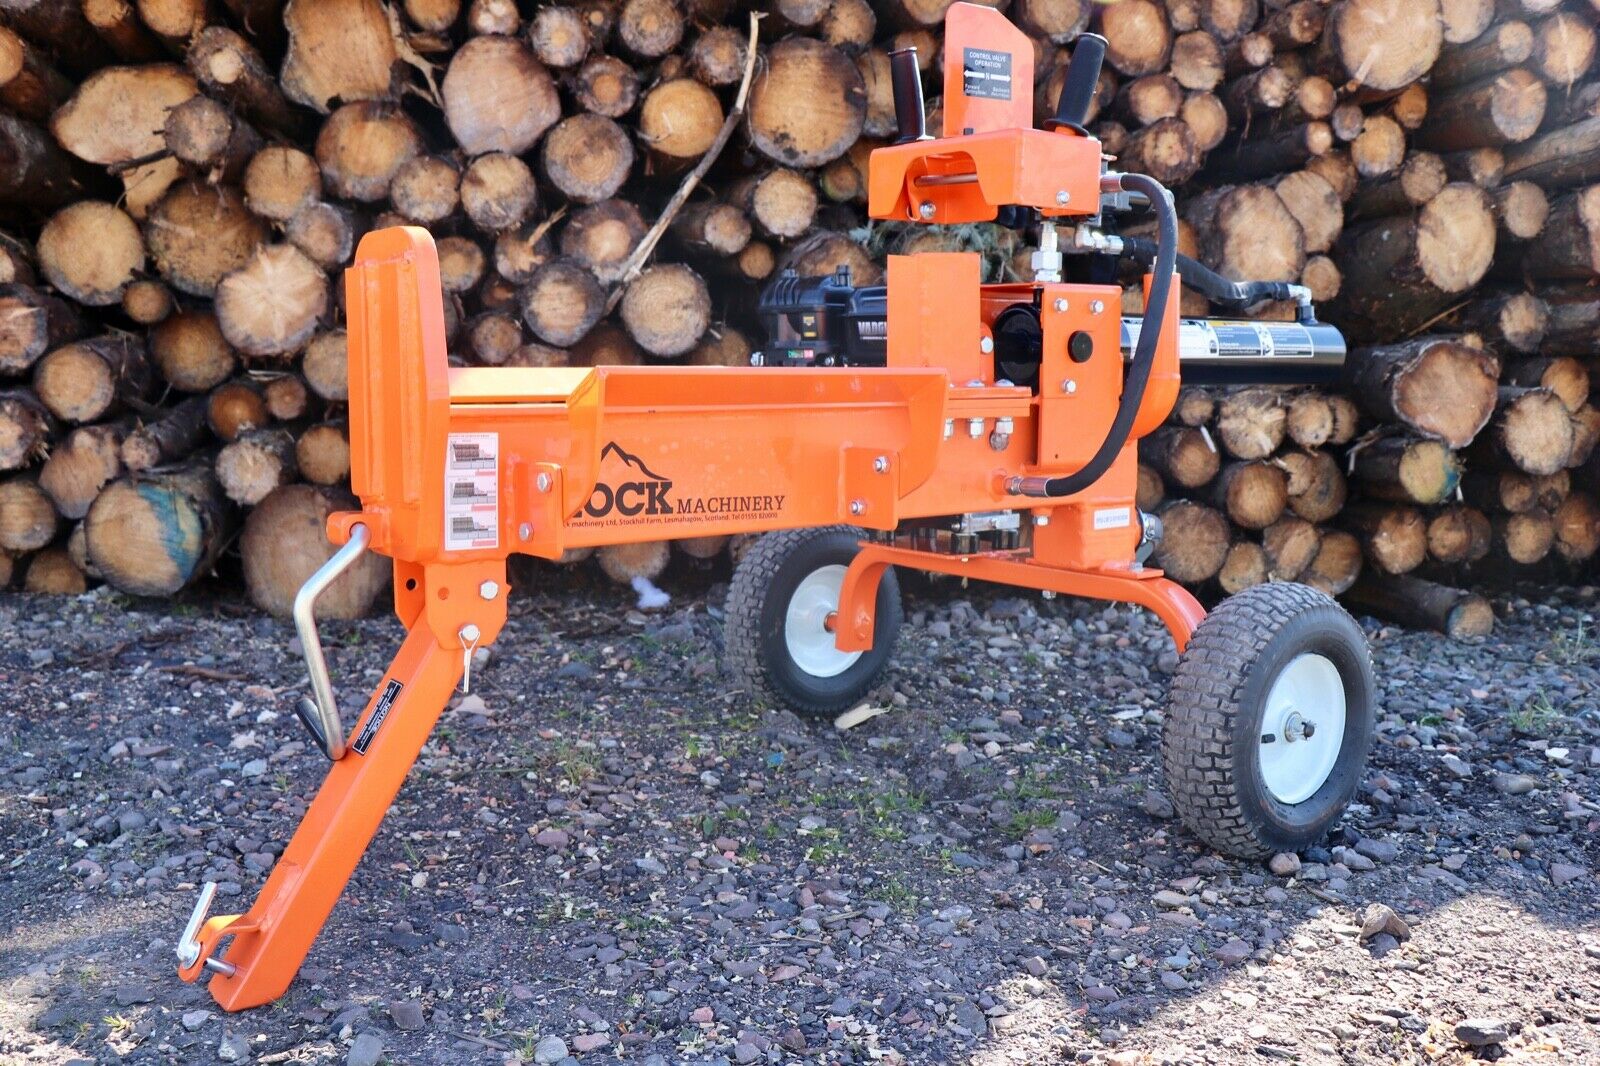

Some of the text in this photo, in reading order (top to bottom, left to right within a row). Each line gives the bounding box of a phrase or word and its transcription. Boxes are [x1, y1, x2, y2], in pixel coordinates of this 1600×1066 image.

[969, 52, 992, 60] CONTROL
[974, 60, 1001, 68] OPERATION
[573, 481, 673, 518] OCK
[677, 495, 785, 514] MACHINERY
[572, 519, 604, 528] machinery
[619, 517, 645, 525] Stockhill
[664, 514, 703, 523] Lesmahagow,
[741, 512, 757, 520] 01555
